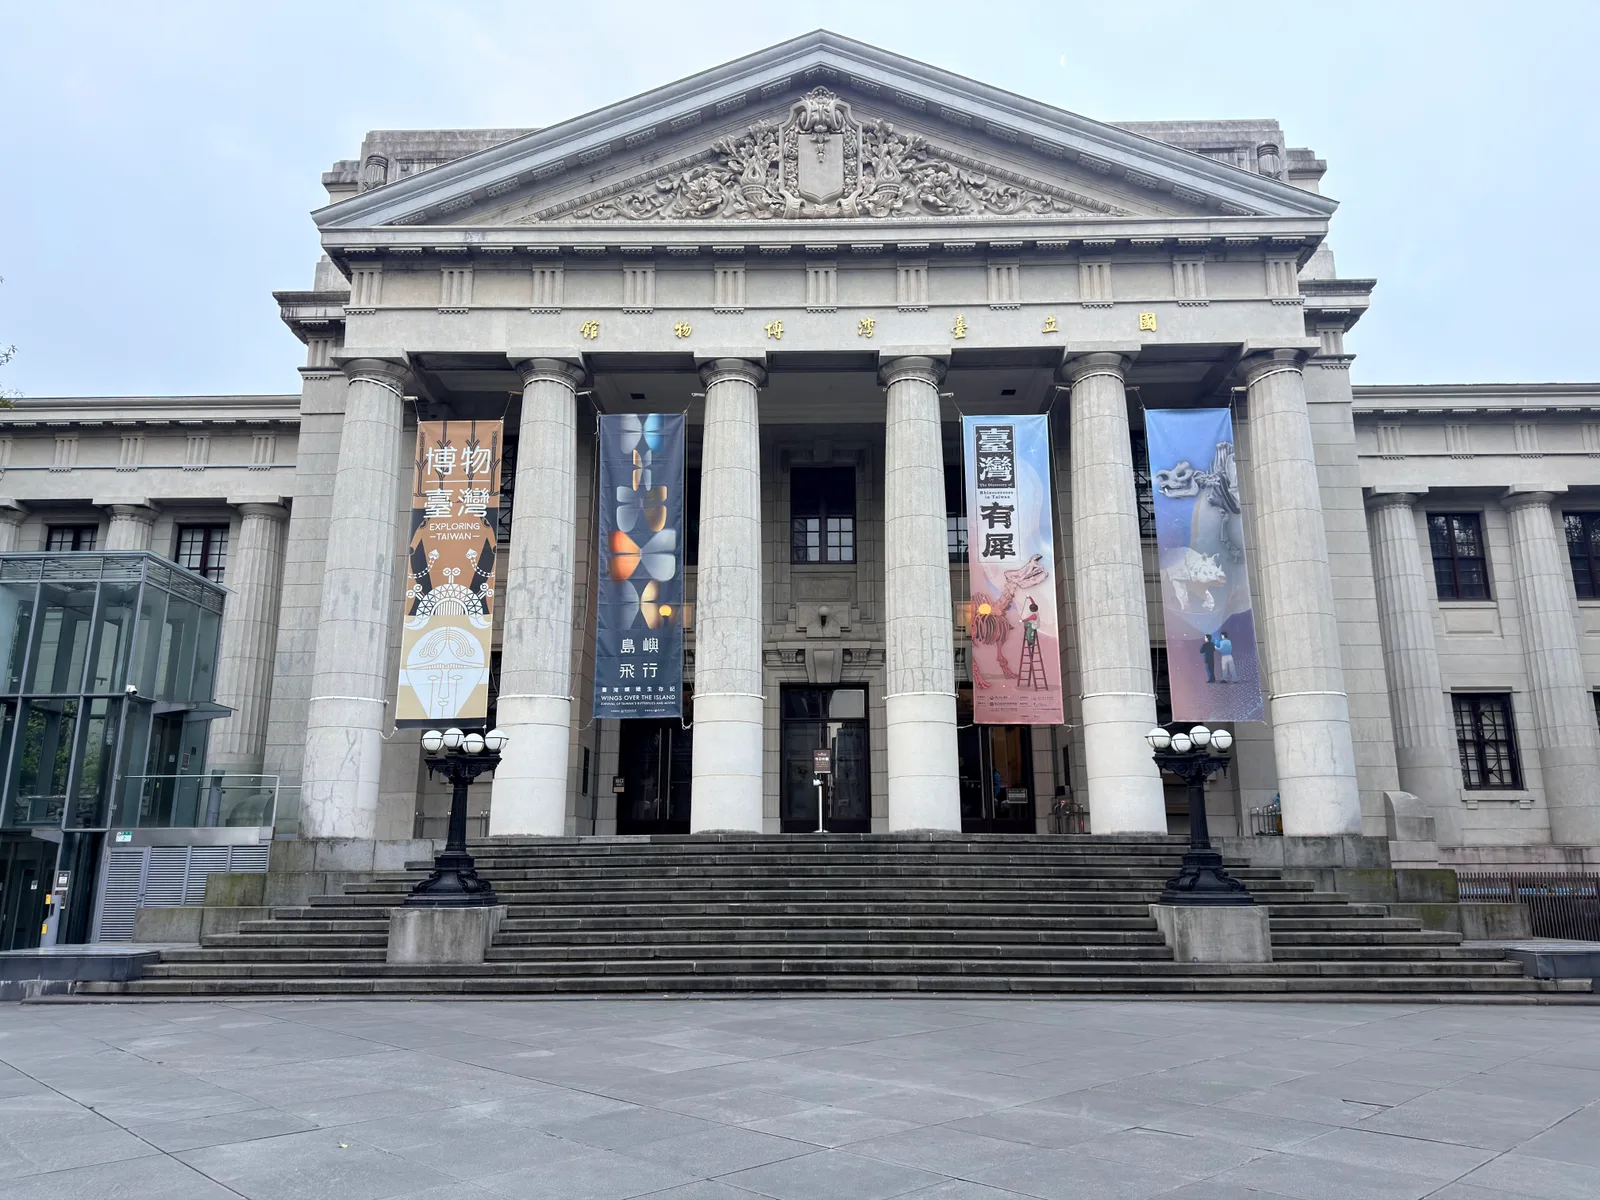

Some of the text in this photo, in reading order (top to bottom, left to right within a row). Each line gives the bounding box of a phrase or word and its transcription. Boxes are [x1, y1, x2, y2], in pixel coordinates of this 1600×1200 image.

[426, 446, 491, 475] 博物
[978, 428, 1012, 481] 臺灣
[423, 488, 490, 518] 臺灣
[429, 522, 480, 531] EXPLORING
[620, 637, 659, 654] 島嶼
[620, 663, 658, 678] 飛行
